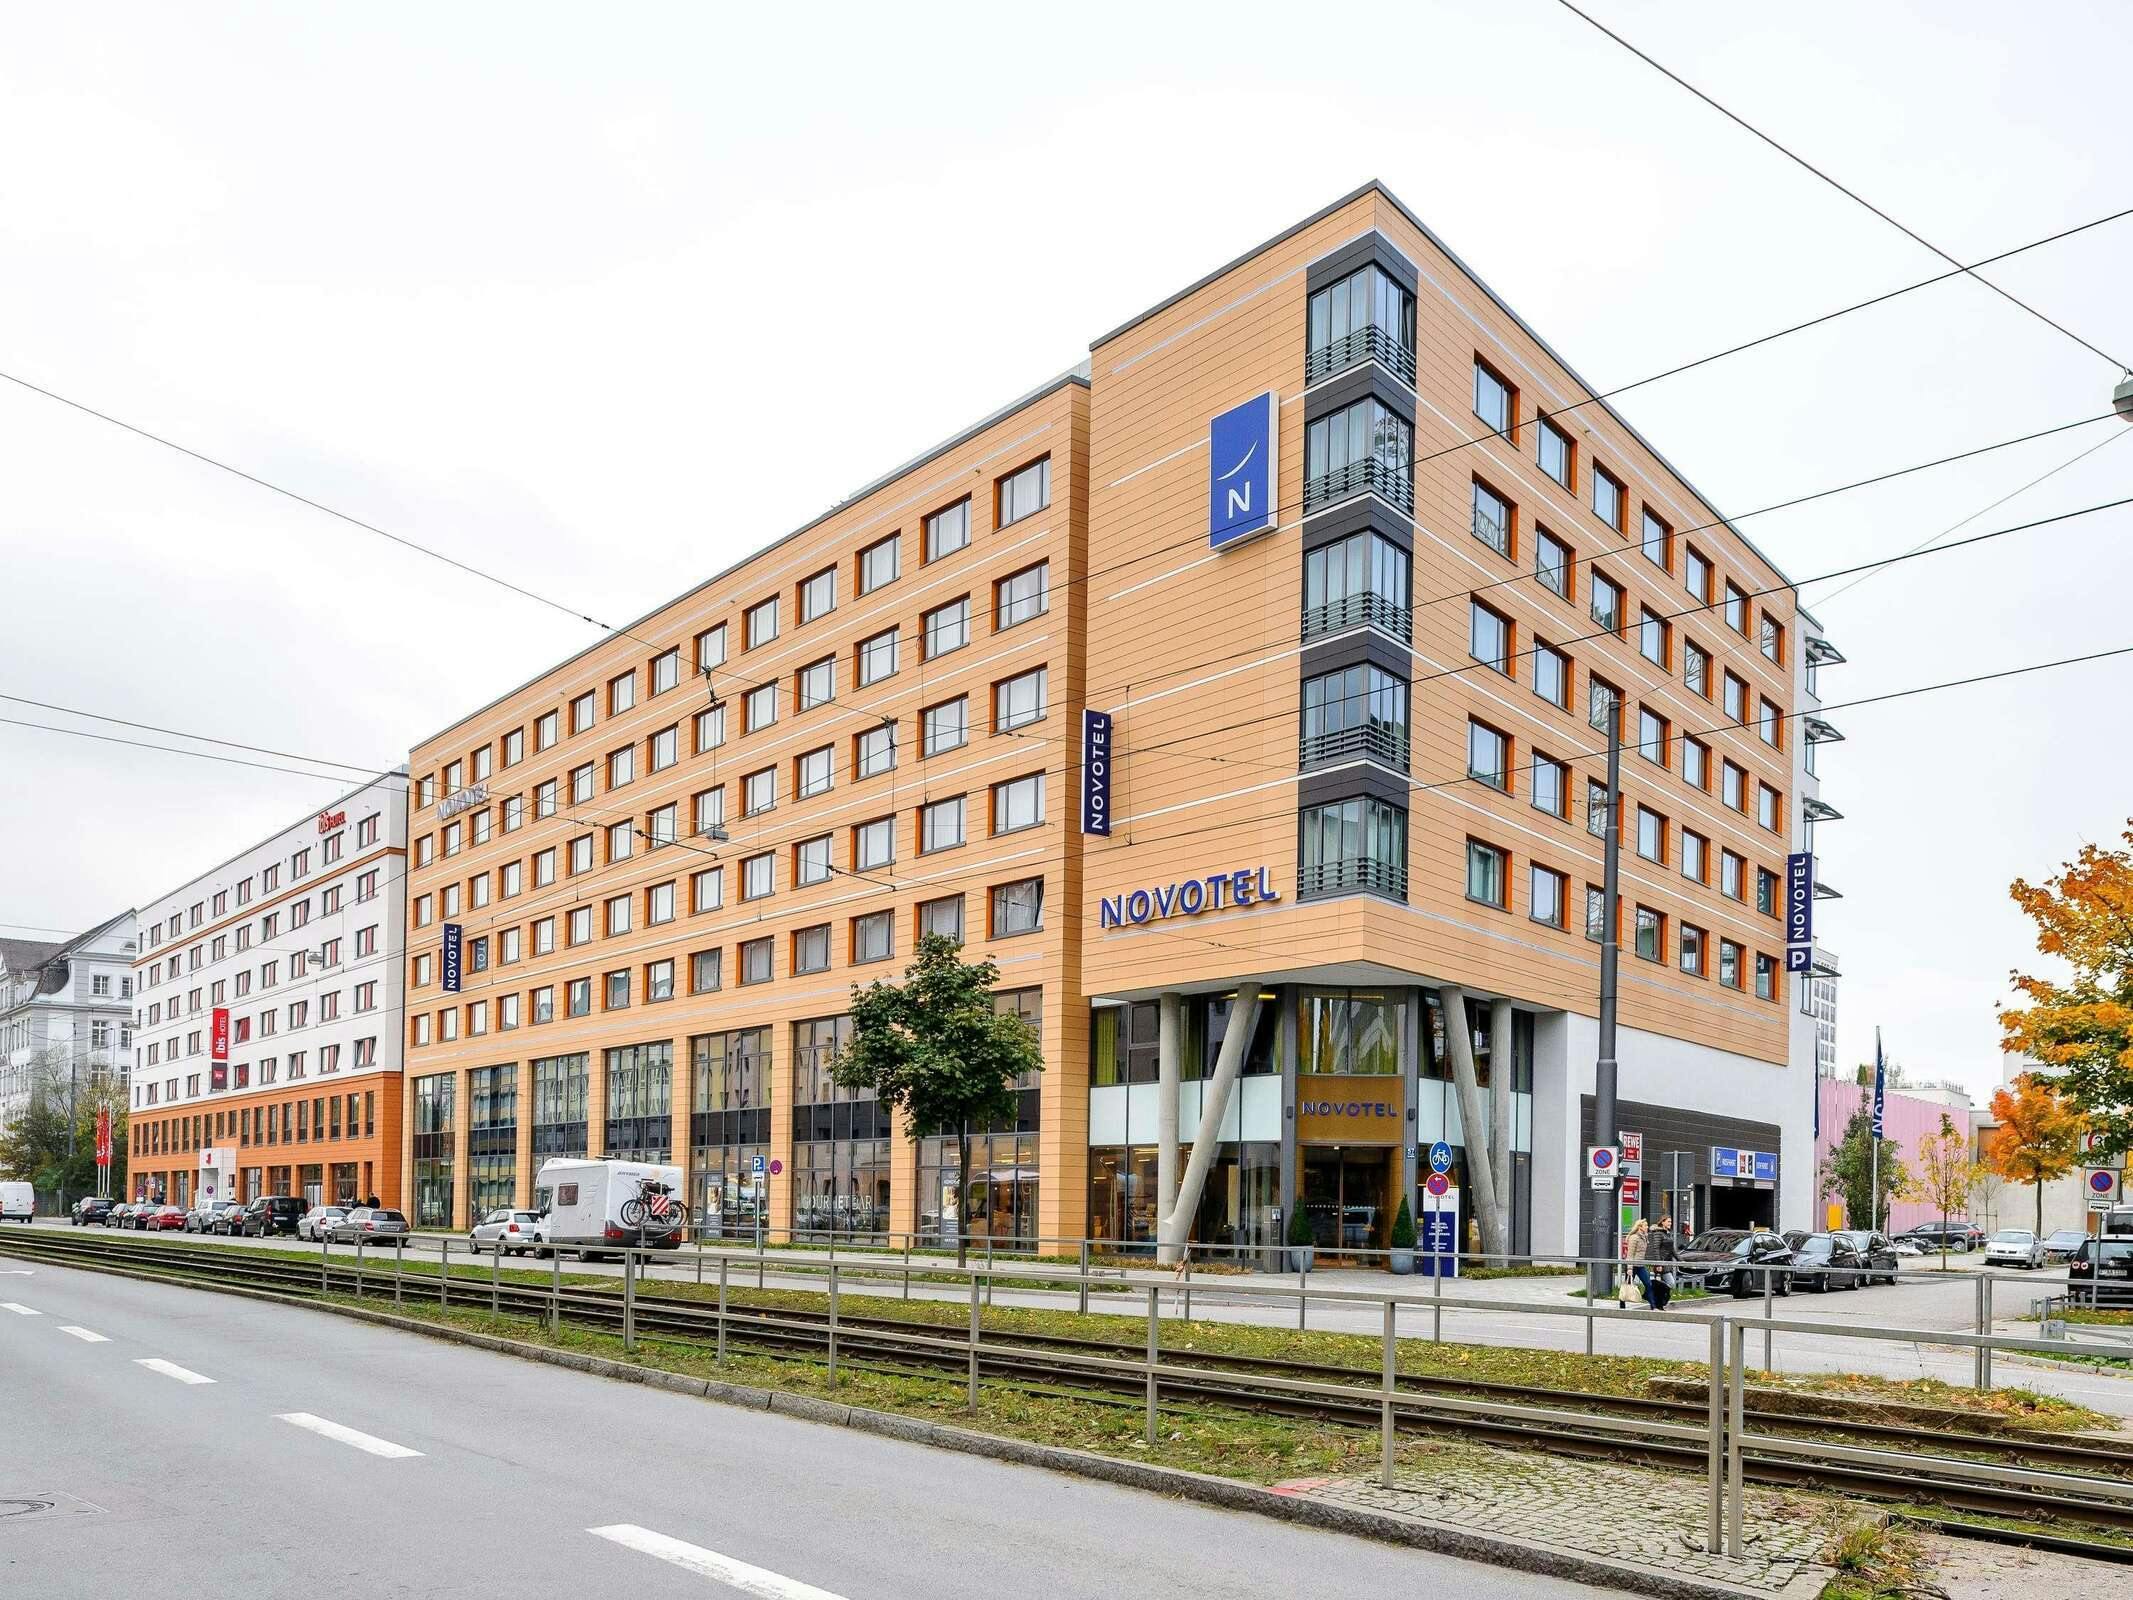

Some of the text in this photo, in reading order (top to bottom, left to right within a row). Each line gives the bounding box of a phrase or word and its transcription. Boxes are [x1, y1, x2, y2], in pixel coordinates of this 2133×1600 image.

[1228, 480, 1250, 520] N
[1091, 718, 1105, 830] NOVOTEL
[1101, 866, 1281, 929] NOVOTEL
[1793, 857, 1806, 939] NOVOTEL
[447, 927, 458, 989] NOVOTEL
[1791, 951, 1806, 968] P
[216, 1037, 226, 1053] ibis
[1302, 1101, 1398, 1117] NOVOTEL
[1623, 1135, 1640, 1148] REWE
